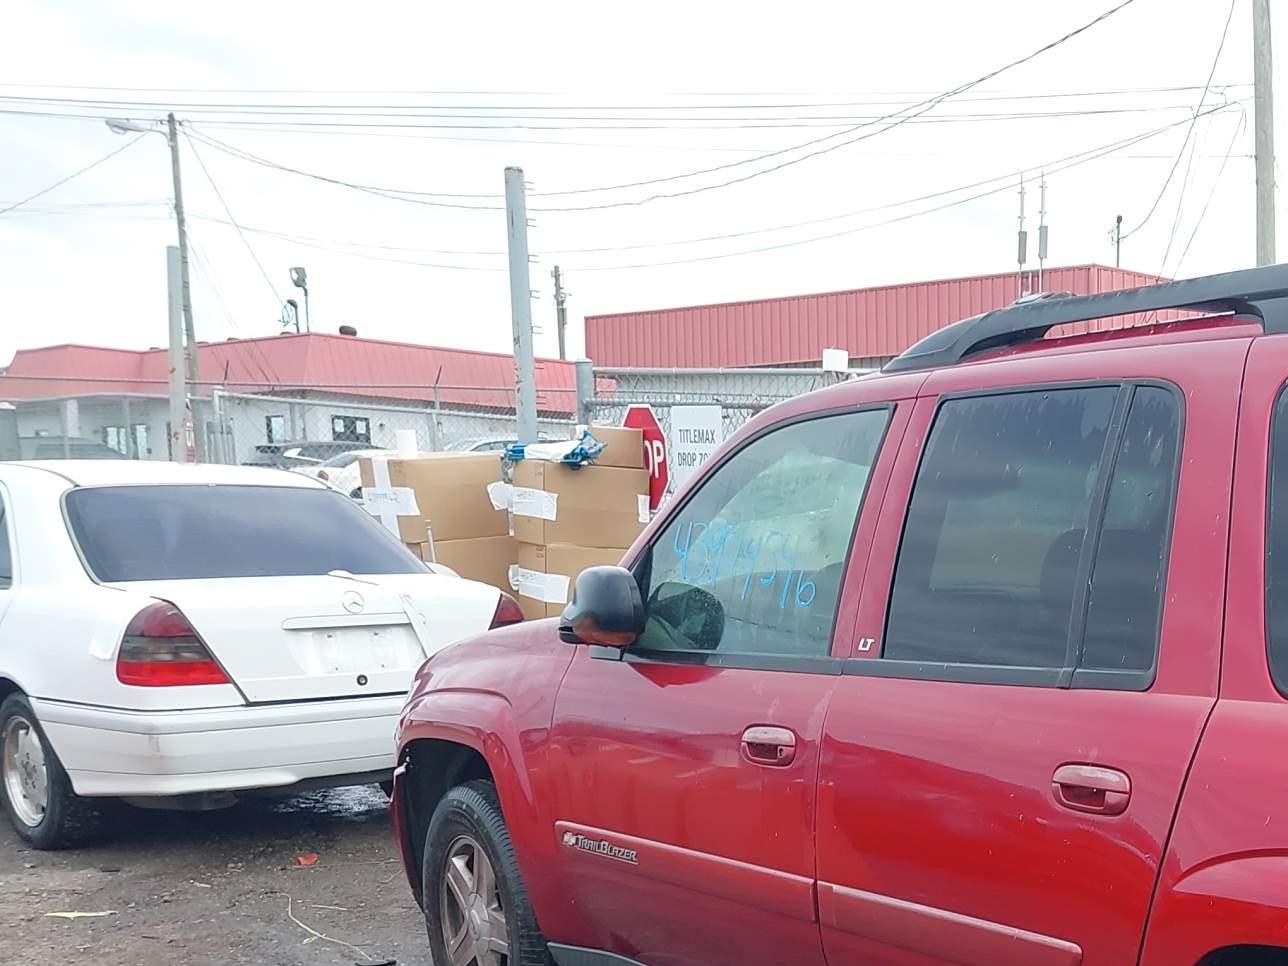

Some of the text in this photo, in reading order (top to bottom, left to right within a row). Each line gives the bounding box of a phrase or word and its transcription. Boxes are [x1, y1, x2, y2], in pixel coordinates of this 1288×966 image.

[678, 429, 716, 444] TITLEMAX
[677, 452, 696, 466] DROP
[857, 637, 875, 651] LT
